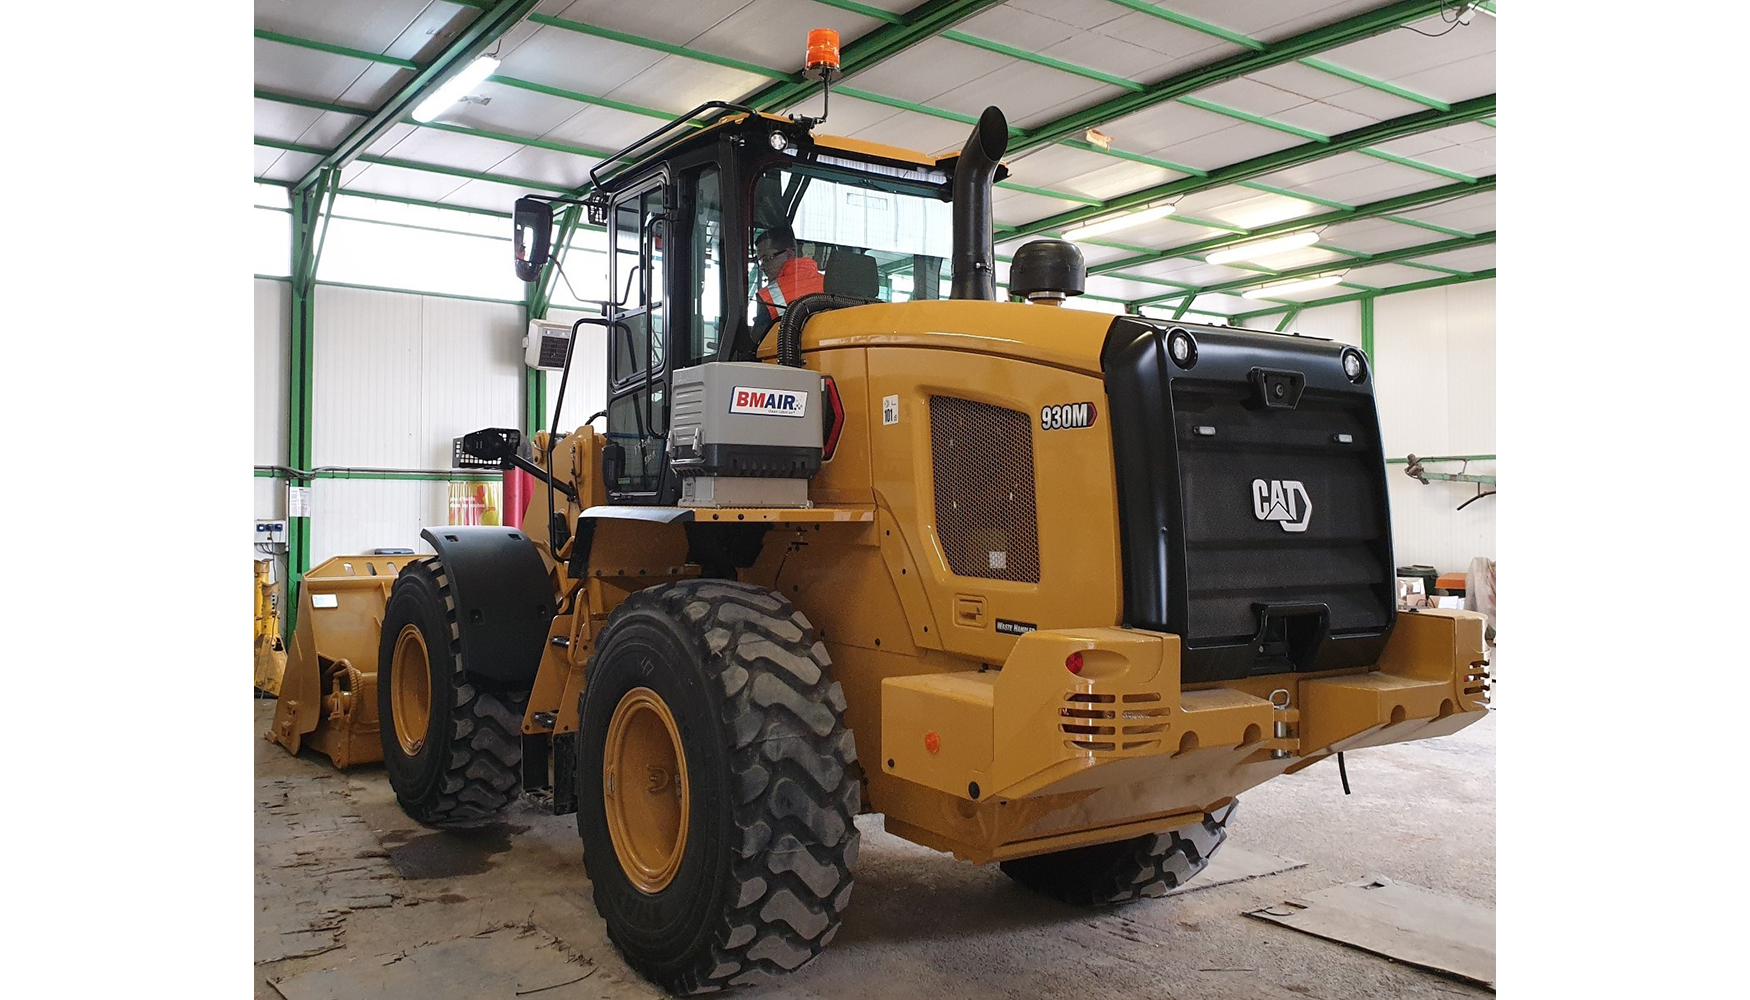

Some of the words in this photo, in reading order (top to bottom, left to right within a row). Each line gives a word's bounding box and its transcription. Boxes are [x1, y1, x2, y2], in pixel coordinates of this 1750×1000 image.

[736, 391, 796, 410] BMAIR
[1042, 403, 1088, 429] 930M
[1253, 479, 1300, 520] CAT
[997, 622, 1013, 631] WASTE
